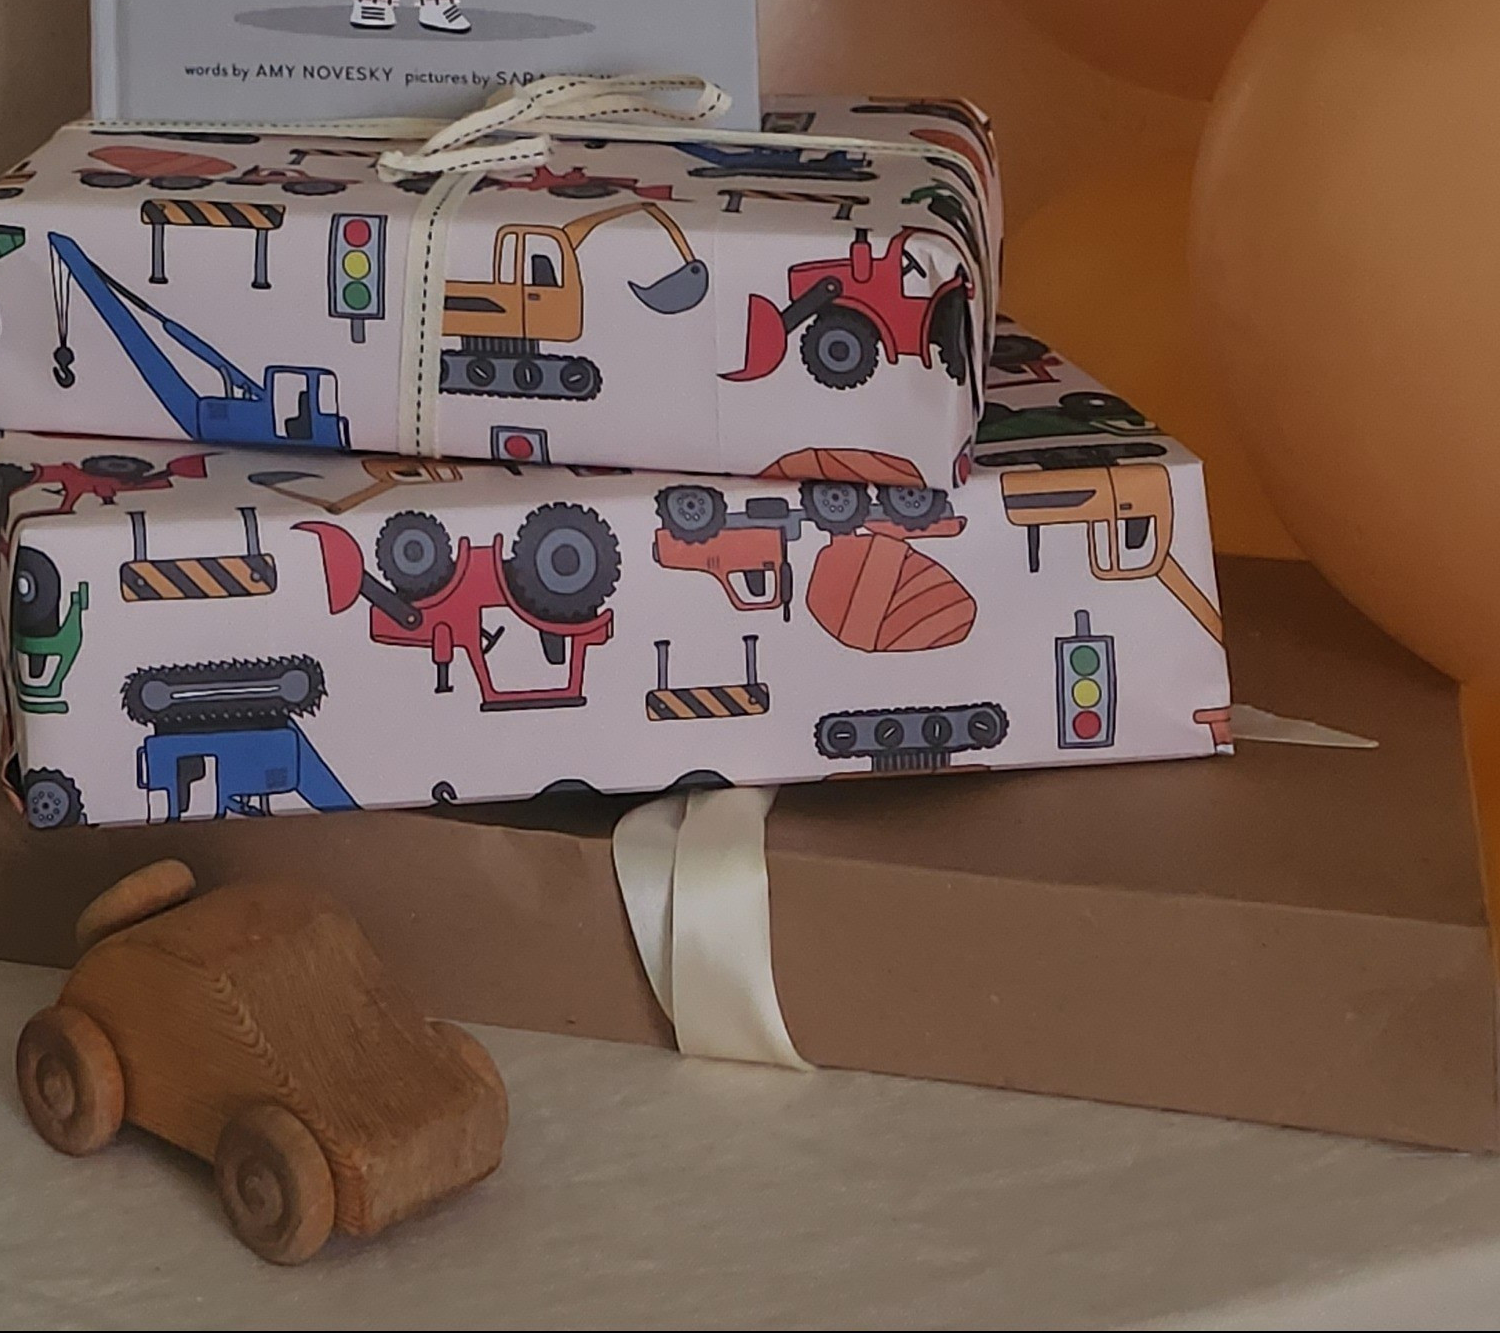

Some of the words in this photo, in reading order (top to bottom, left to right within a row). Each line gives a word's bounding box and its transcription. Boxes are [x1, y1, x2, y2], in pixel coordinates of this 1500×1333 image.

[184, 62, 229, 78] words
[231, 62, 250, 82] by
[255, 63, 296, 79] AMY
[302, 64, 393, 83] NOVESKY
[404, 70, 469, 87] pictures
[471, 71, 491, 90] by
[496, 70, 546, 88] SAR
